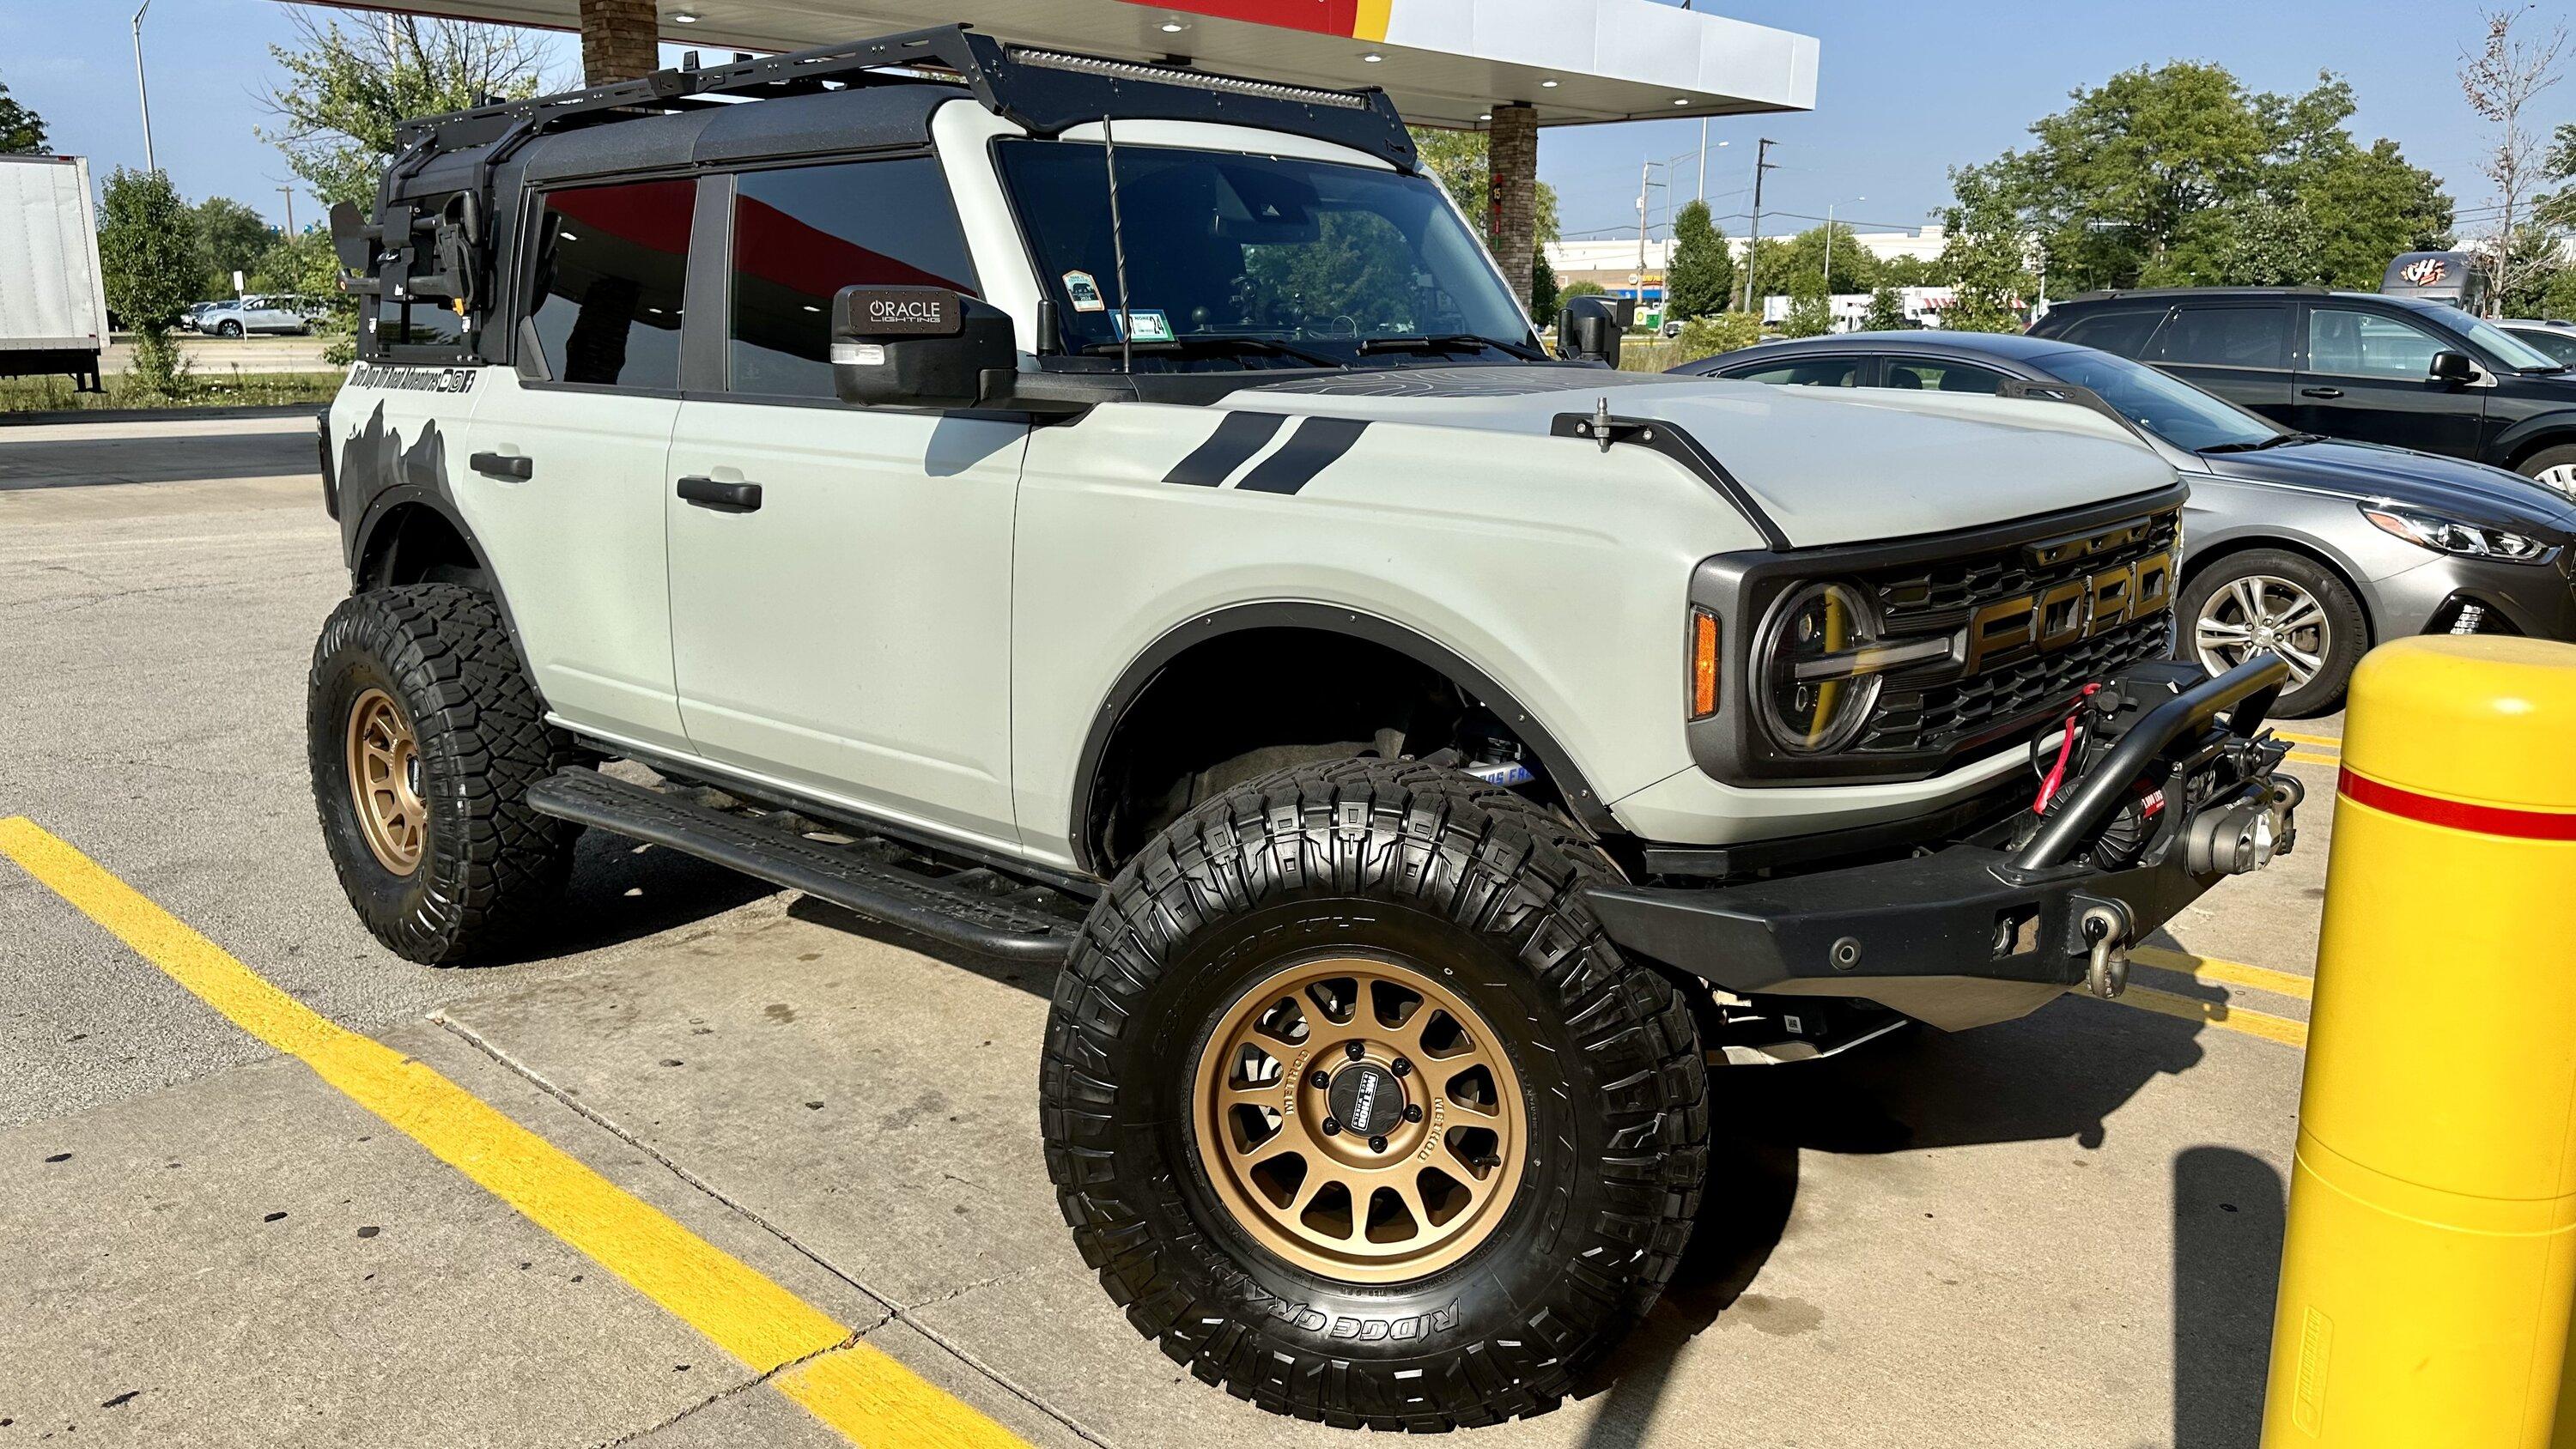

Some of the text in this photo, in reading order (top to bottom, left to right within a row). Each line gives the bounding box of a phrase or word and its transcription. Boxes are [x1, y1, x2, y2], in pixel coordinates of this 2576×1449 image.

[1492, 187, 1501, 200] 15
[869, 300, 941, 318] ORACLE
[1149, 315, 1165, 335] 24
[383, 367, 407, 389] Road
[1966, 551, 2172, 677] FORD
[1283, 1048, 1311, 1116] METHOD
[1352, 1073, 1370, 1127] RACE WHEELS
[1358, 1075, 1377, 1128] METHOD
[1417, 1096, 1446, 1164] METHOD
[1330, 1296, 1461, 1343] RIDGE
